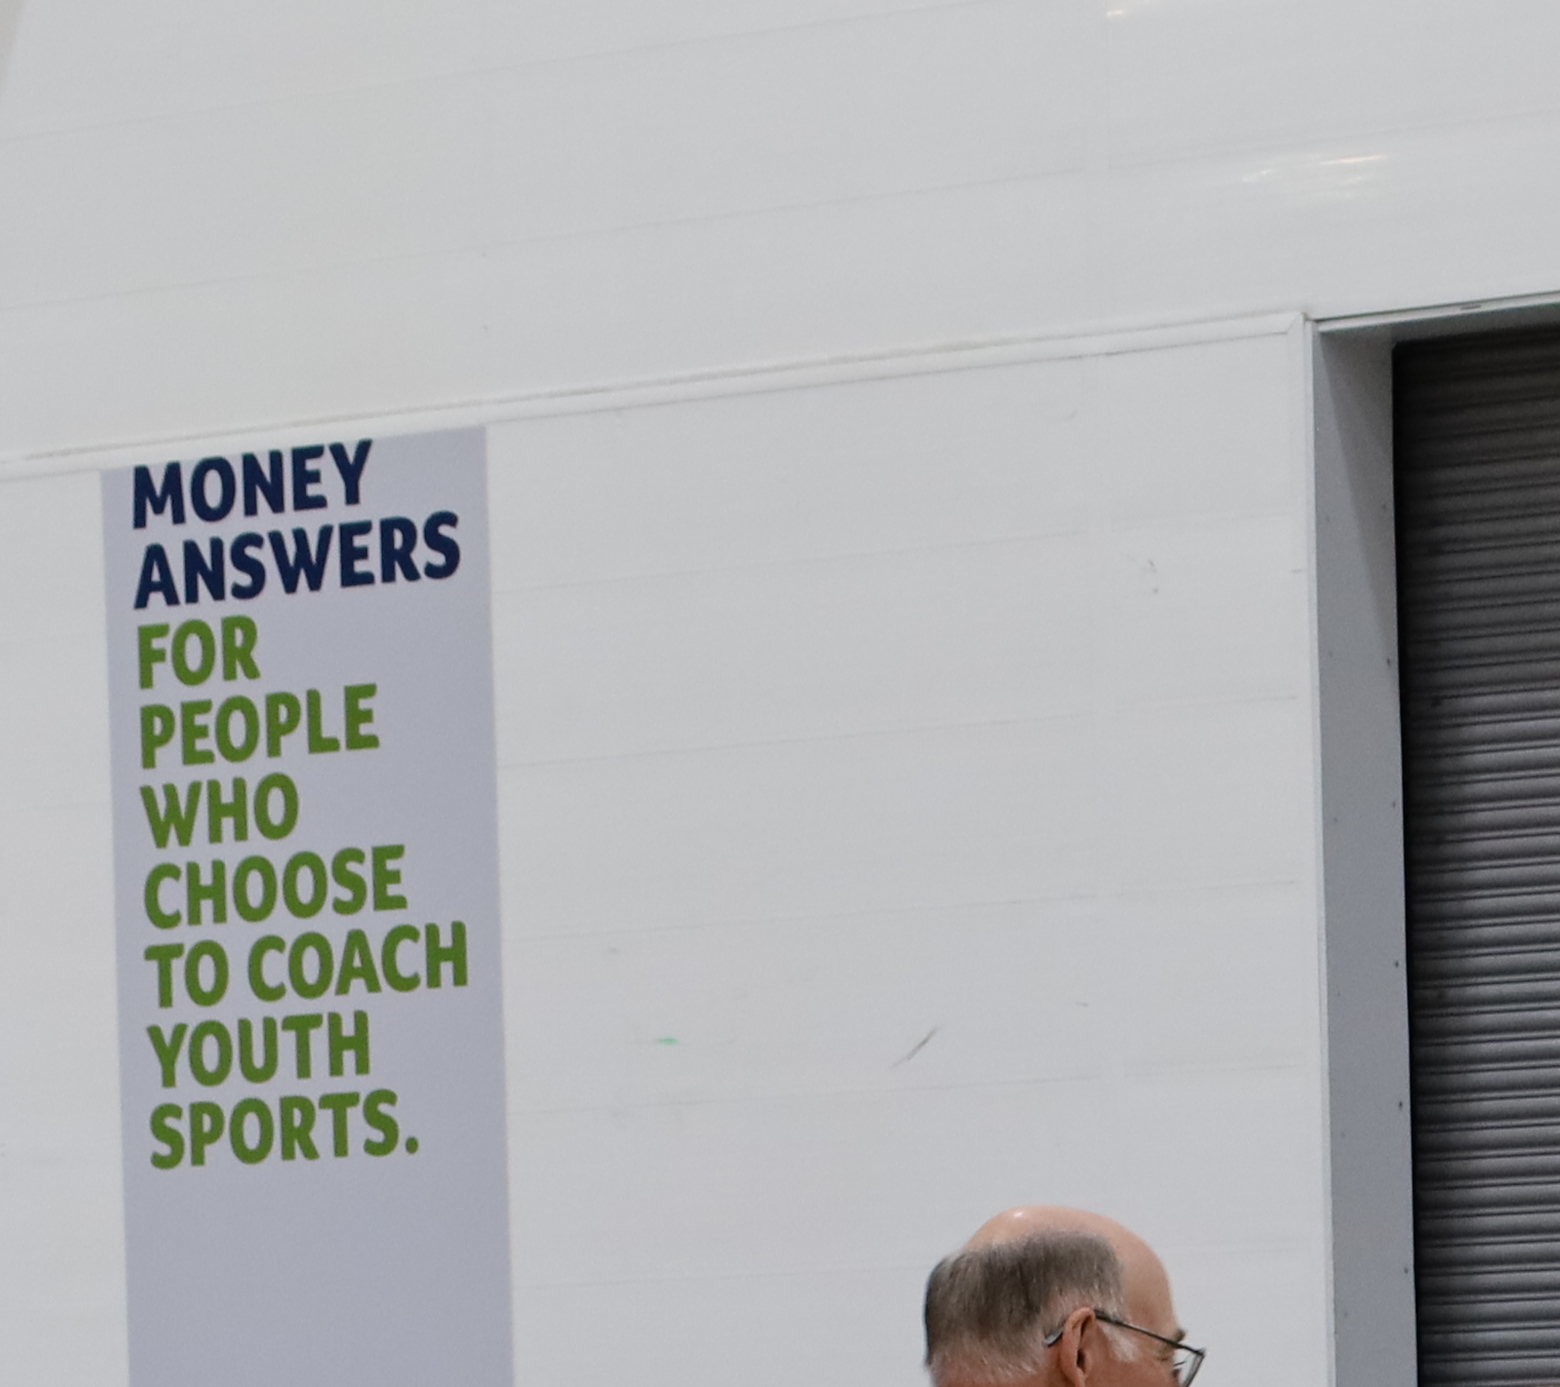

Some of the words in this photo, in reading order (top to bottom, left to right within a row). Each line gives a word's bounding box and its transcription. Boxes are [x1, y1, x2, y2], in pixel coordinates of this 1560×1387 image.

[133, 439, 373, 530] MONEY
[133, 510, 460, 610] ANSWERS
[138, 615, 261, 690] FOR
[139, 683, 380, 769] PEOPLE
[140, 772, 299, 849] WHO
[144, 844, 408, 929] CHOOSE
[144, 940, 229, 1008] TO
[248, 920, 468, 1002] COACH
[146, 1009, 370, 1088] YOUTH
[150, 1088, 419, 1170] SPORTS.
